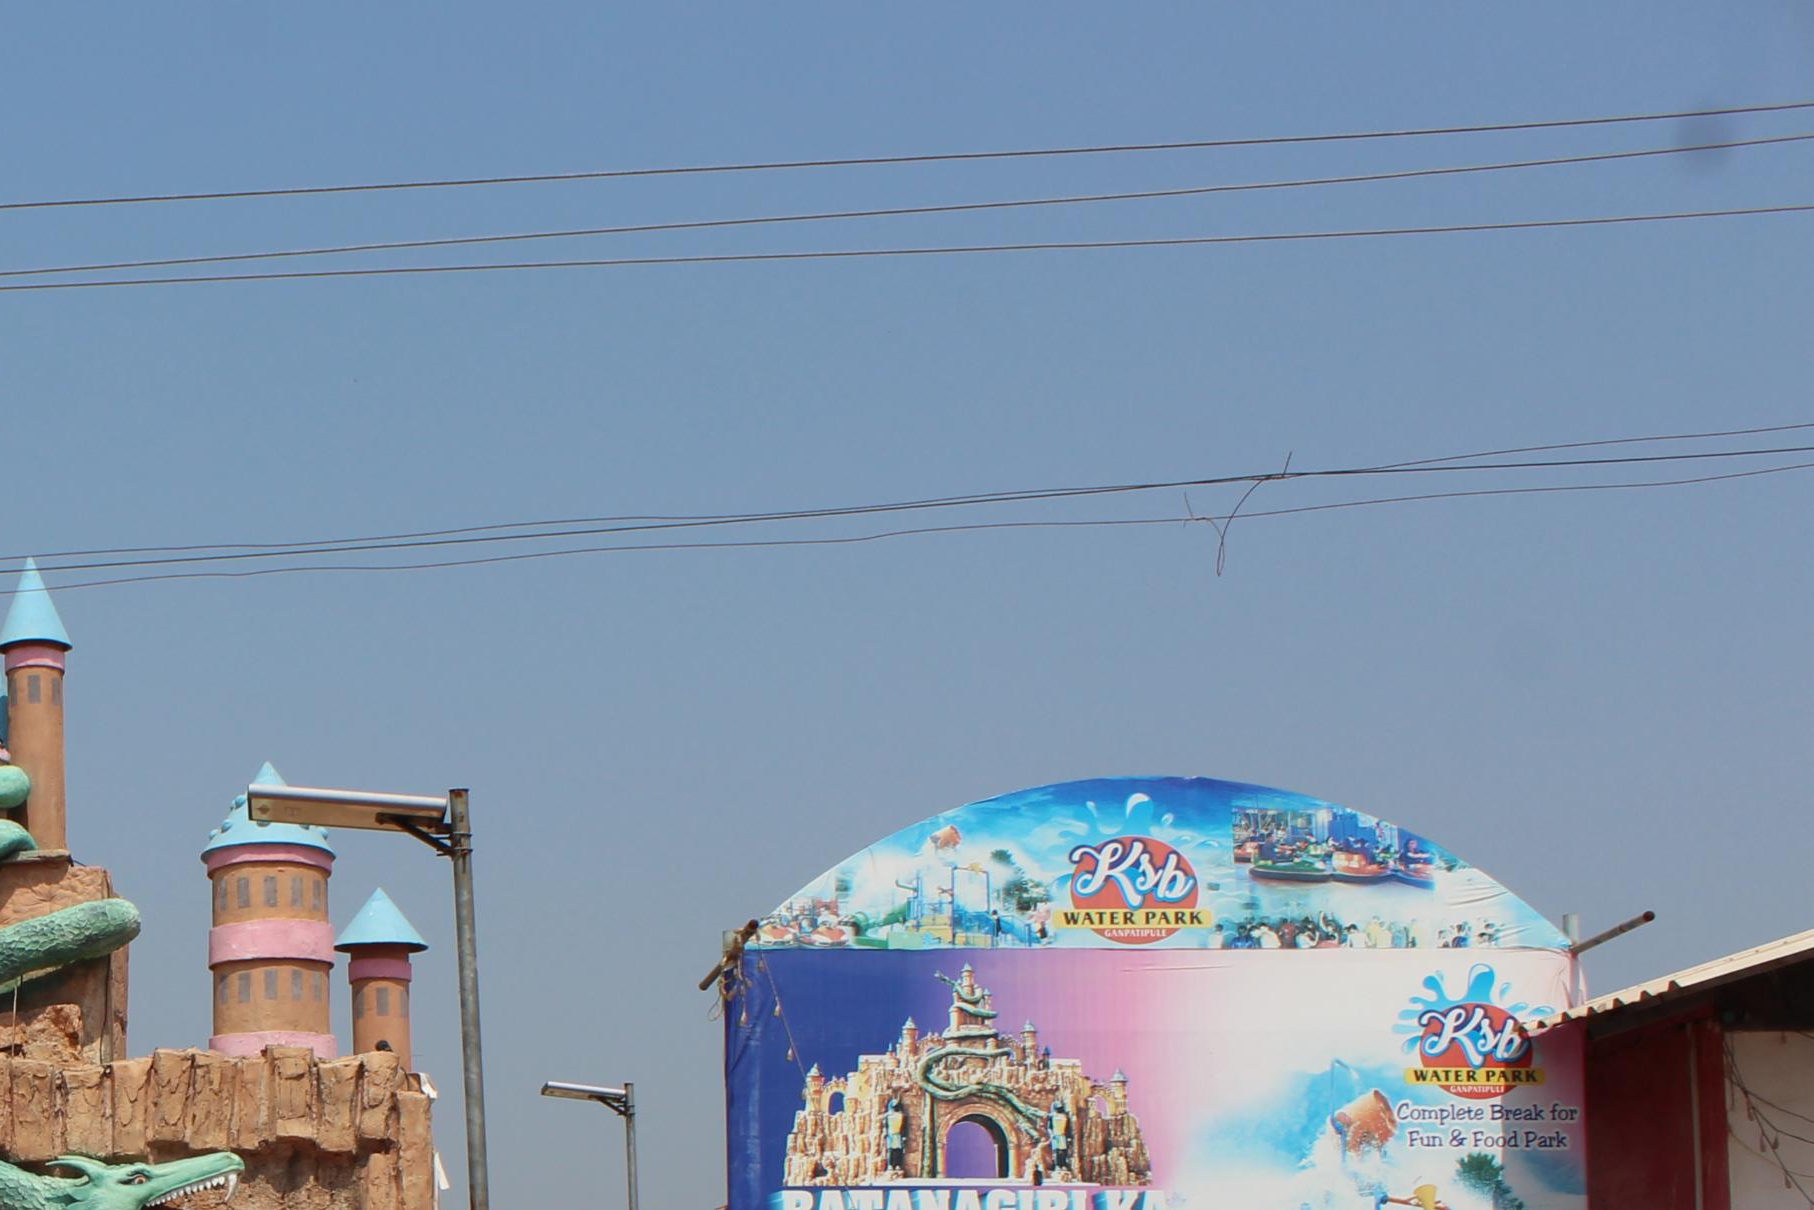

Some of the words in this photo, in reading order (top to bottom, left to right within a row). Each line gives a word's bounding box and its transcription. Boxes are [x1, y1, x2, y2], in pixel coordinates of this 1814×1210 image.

[1070, 840, 1197, 910] Ksb
[1063, 911, 1136, 925] WATER
[1144, 911, 1204, 925] PARK
[1104, 928, 1167, 938] GANPATIPULE
[1419, 1004, 1531, 1069] Ksb
[1413, 1070, 1478, 1082] WATER
[1485, 1070, 1538, 1082] PARK
[1396, 1102, 1485, 1125] Complete
[1490, 1104, 1545, 1121] Break
[1549, 1102, 1578, 1121] for
[1407, 1130, 1443, 1148] Fun
[1449, 1129, 1467, 1148] &
[1472, 1130, 1519, 1148] Food
[1524, 1130, 1568, 1148] Park
